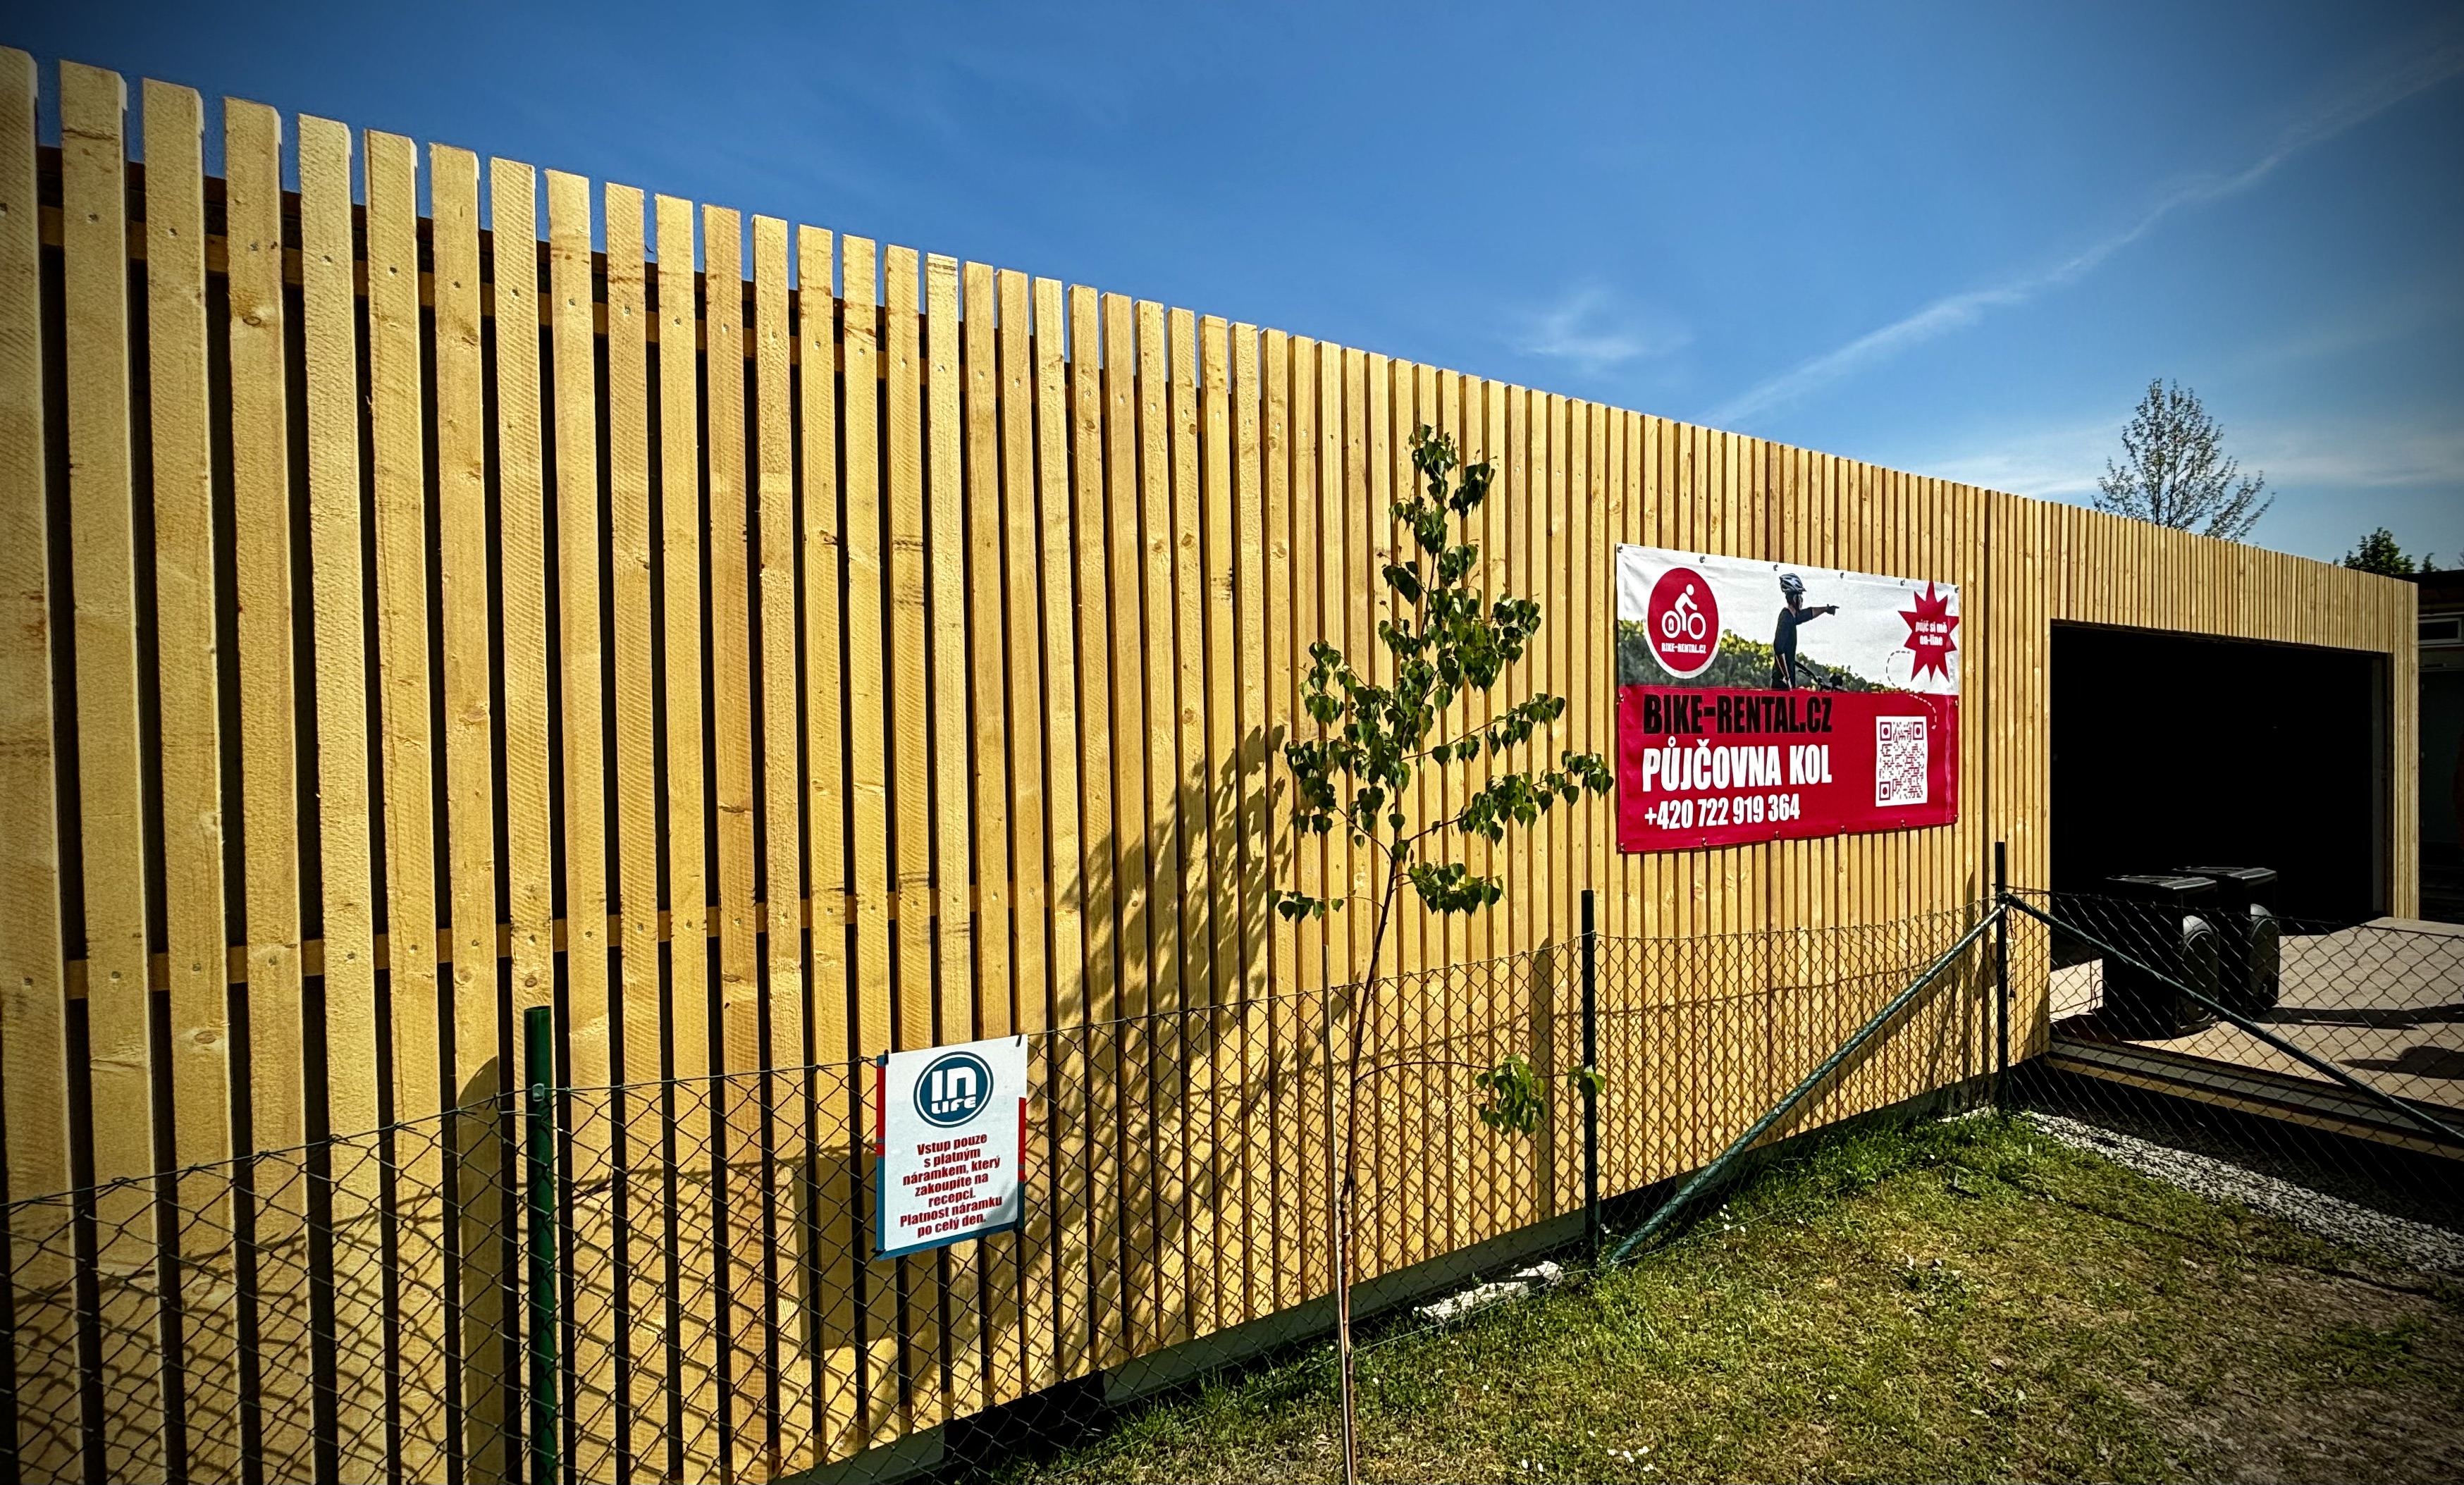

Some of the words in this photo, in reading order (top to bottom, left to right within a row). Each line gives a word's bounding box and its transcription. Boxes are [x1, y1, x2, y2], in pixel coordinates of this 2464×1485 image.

[1644, 694, 1832, 734] BIKE-RENTAL.CZ
[1642, 735, 1782, 792] PŮJČOVNA
[1790, 744, 1832, 785] KOL
[1644, 799, 1693, 830] +420
[1697, 797, 1729, 827] 722
[1733, 795, 1763, 825] 919
[1768, 793, 1800, 820] 364
[931, 1096, 976, 1114] LIFE
[917, 1141, 951, 1155] Vstup
[954, 1134, 987, 1150] pouze
[903, 1164, 968, 1185] náramkem,
[971, 1155, 1001, 1172] který
[924, 1157, 931, 1168] s
[933, 1148, 981, 1167] platným
[915, 1176, 972, 1197] zakoupíte
[975, 1173, 989, 1185] na
[928, 1188, 976, 1207] recepci.
[900, 1207, 949, 1227] Platnost
[951, 1196, 1002, 1216] náramku
[918, 1225, 932, 1238] po
[935, 1216, 959, 1233] celý
[962, 1213, 987, 1227] den.
